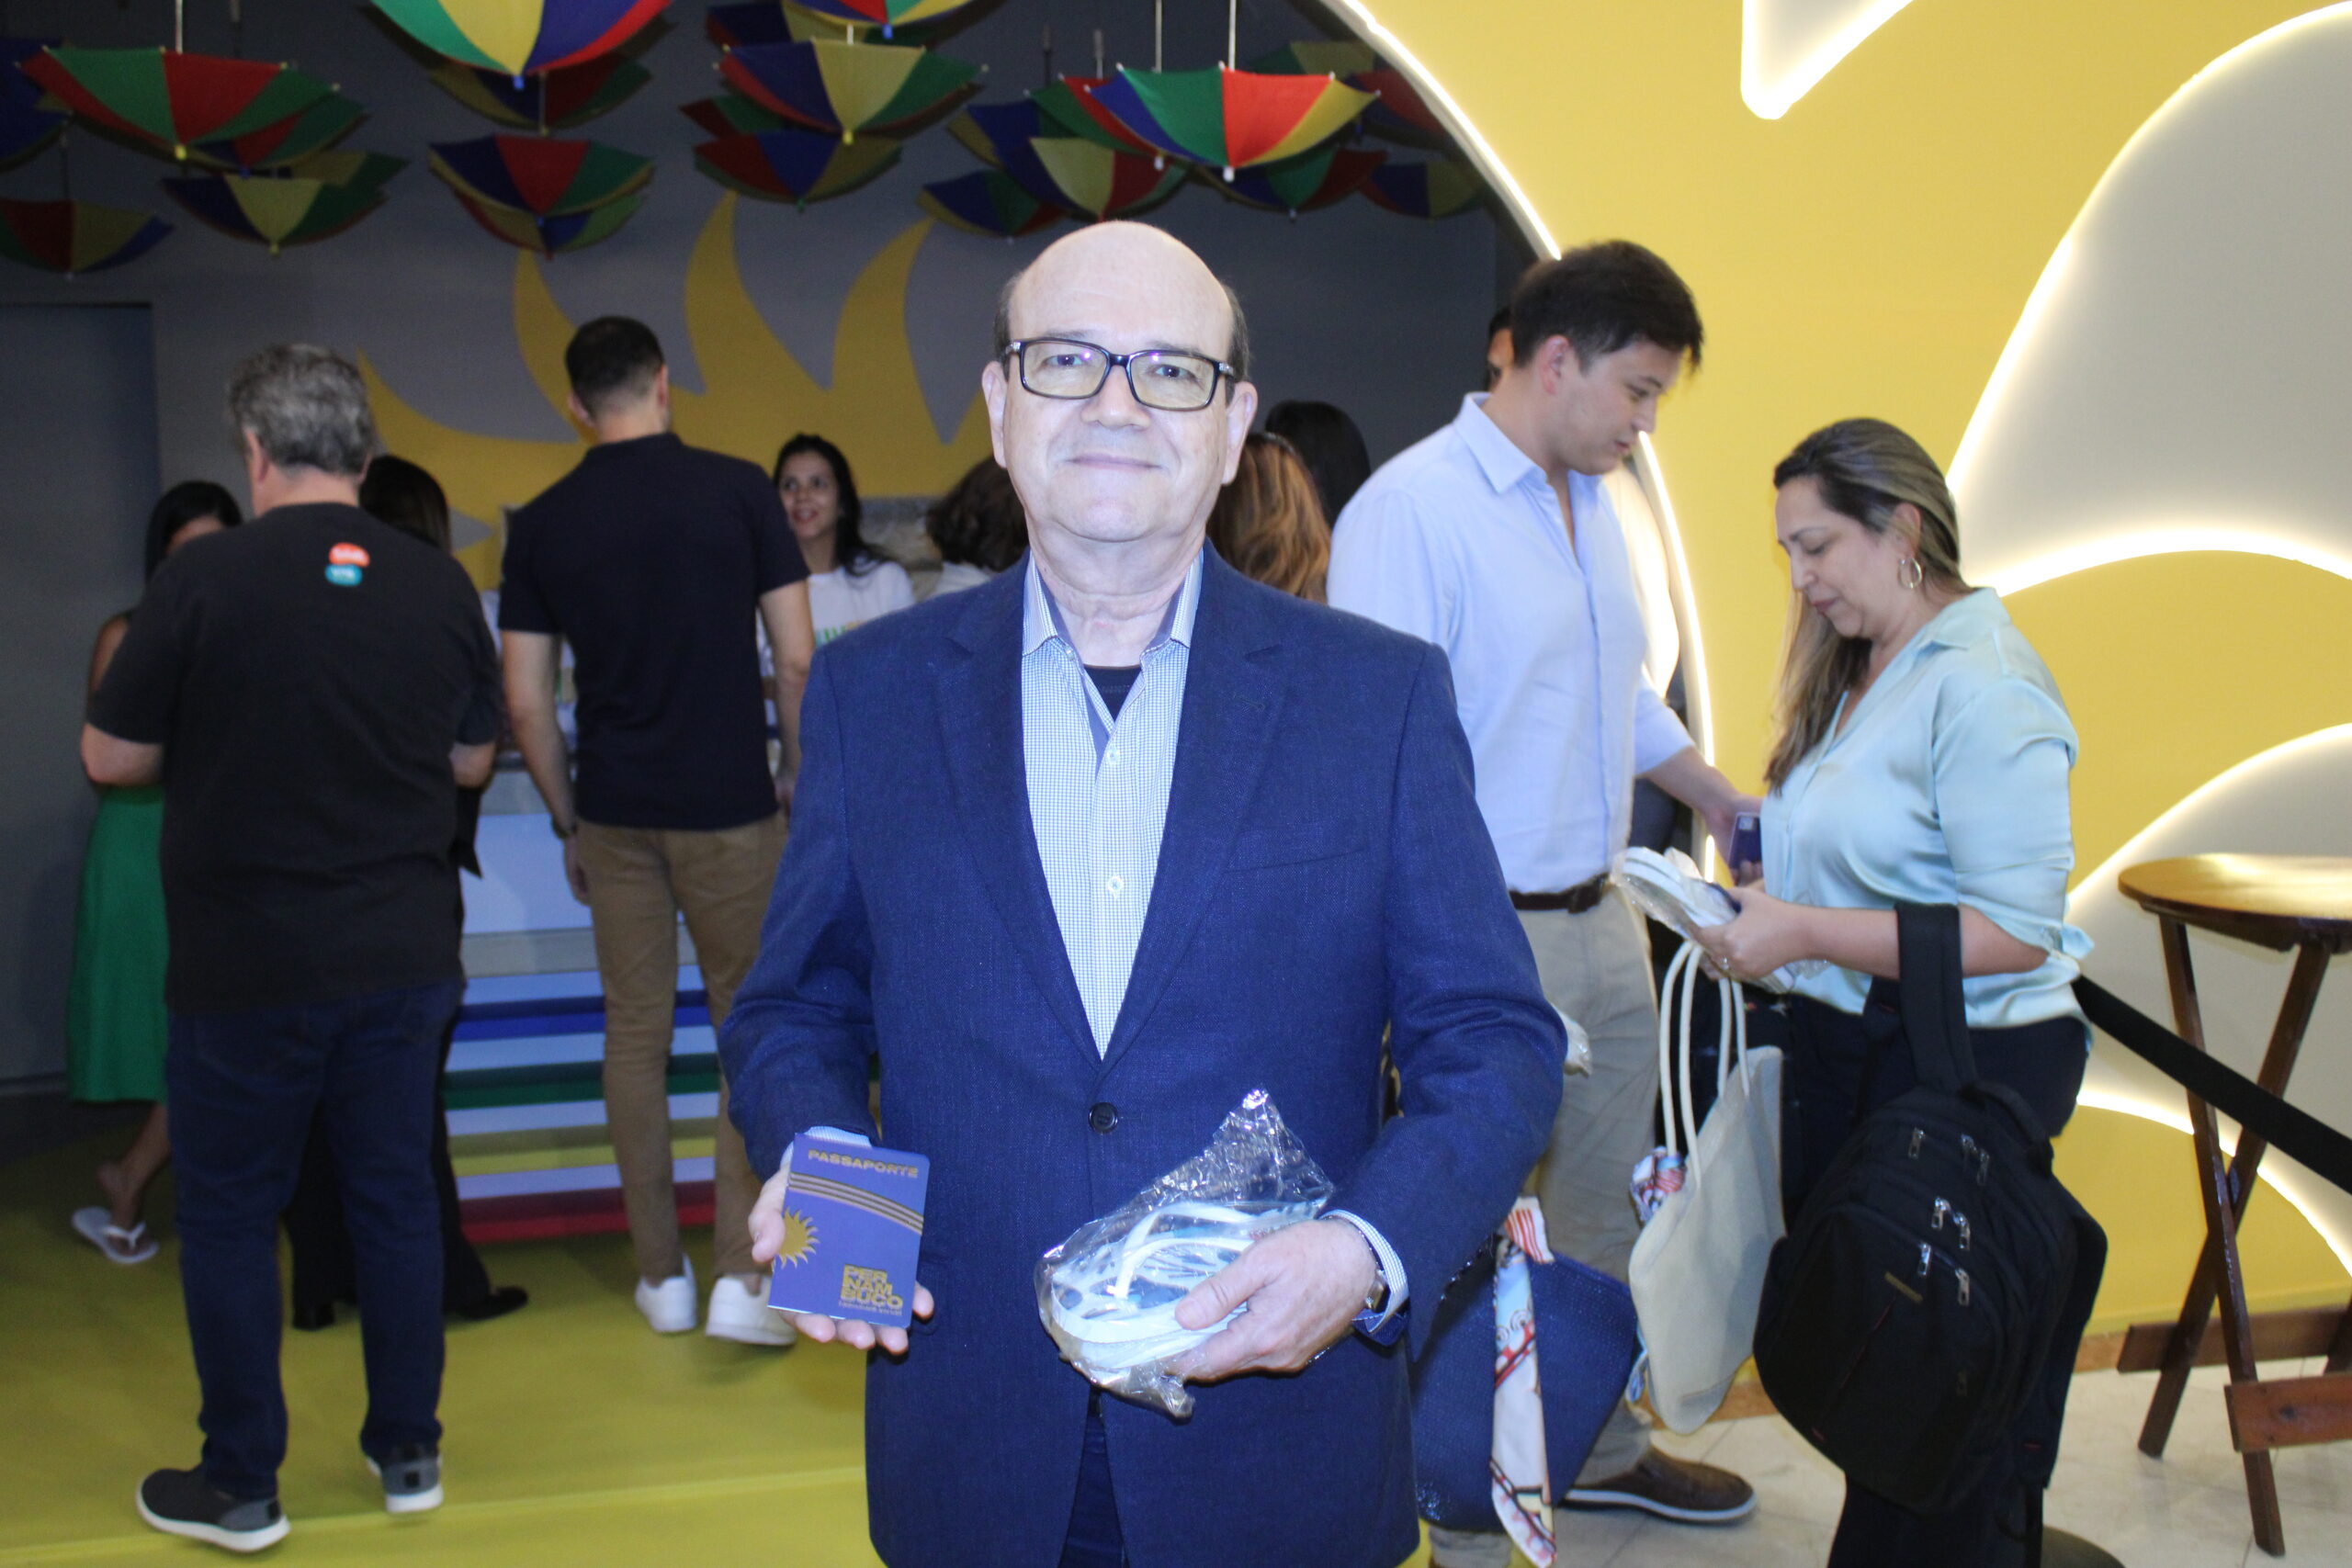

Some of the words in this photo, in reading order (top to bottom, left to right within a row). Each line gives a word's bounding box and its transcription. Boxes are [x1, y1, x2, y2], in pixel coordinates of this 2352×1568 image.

[808, 1149, 919, 1179] PASSAPORTE
[843, 1264, 888, 1283] PER
[842, 1274, 892, 1296] NAM
[841, 1287, 903, 1310] BUCO
